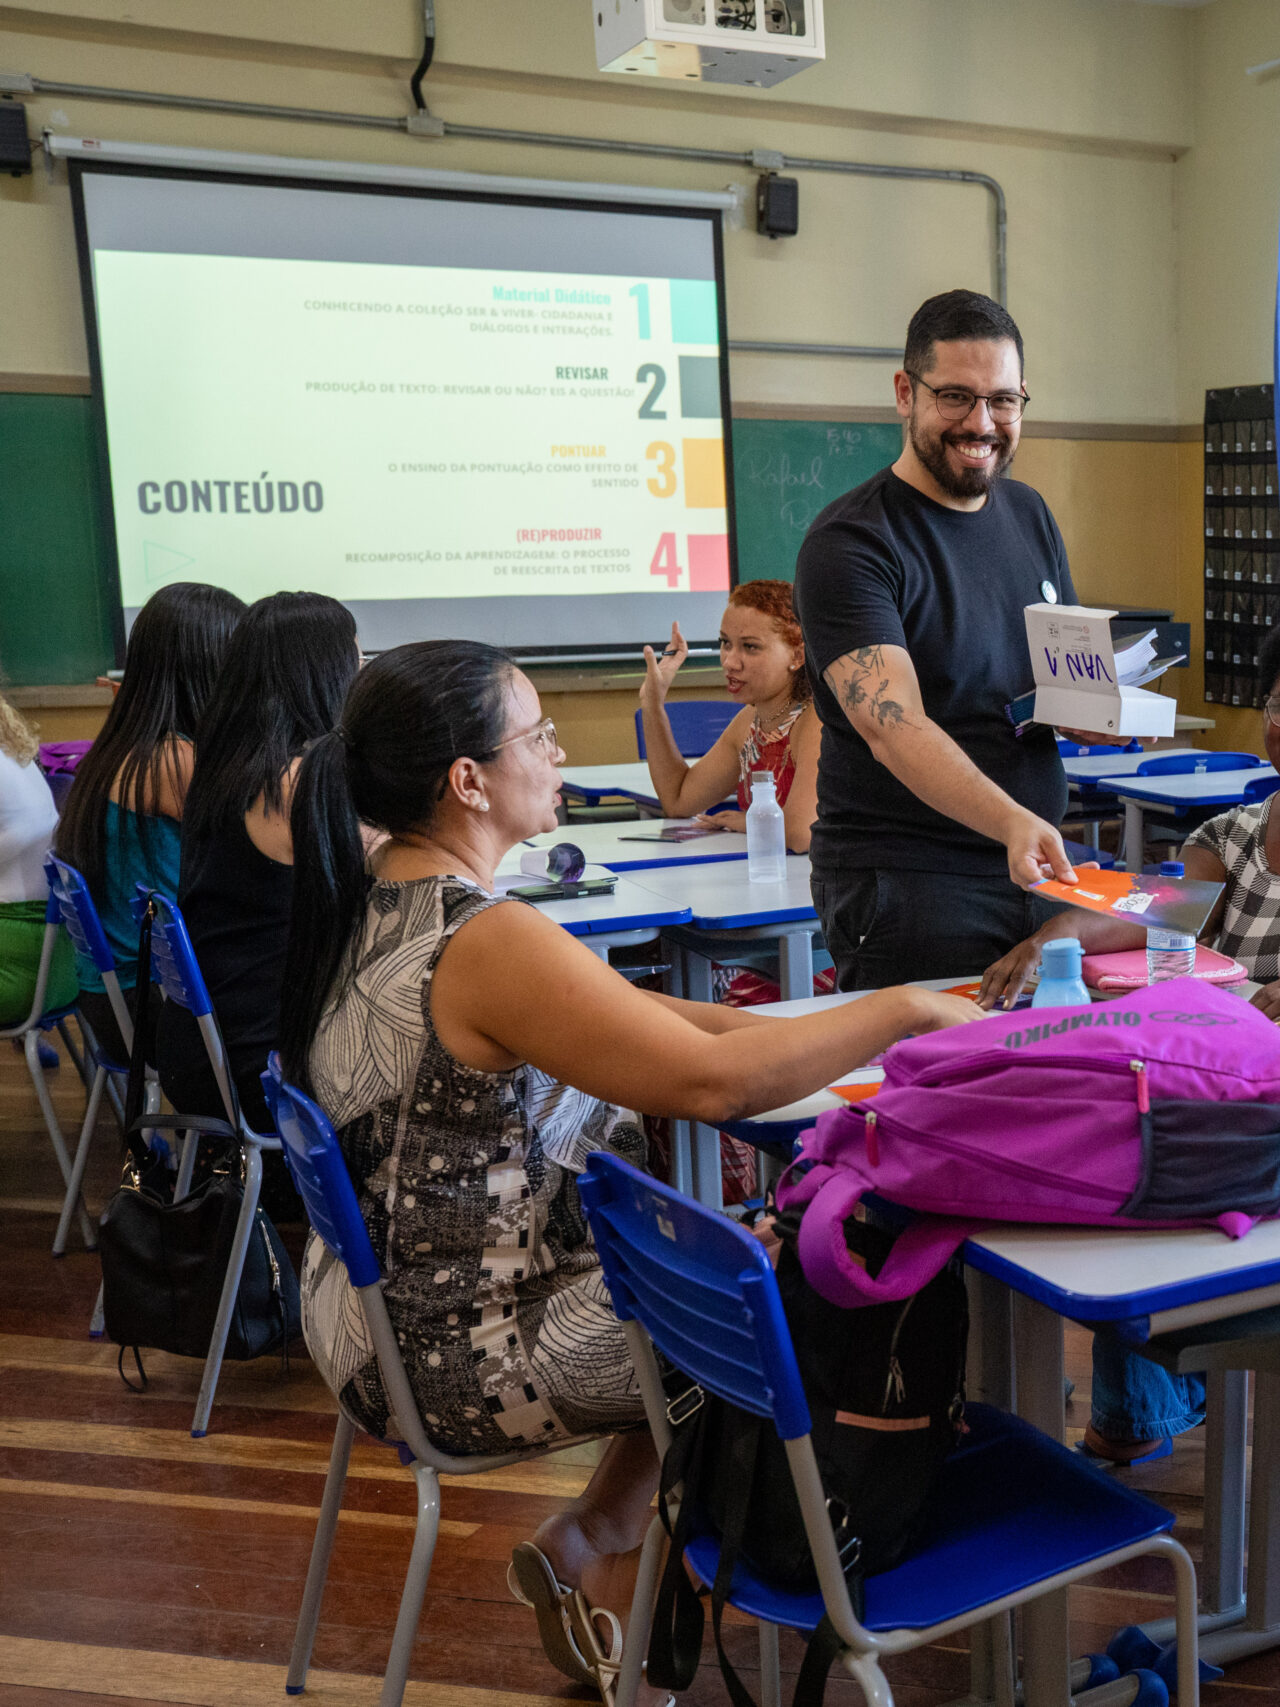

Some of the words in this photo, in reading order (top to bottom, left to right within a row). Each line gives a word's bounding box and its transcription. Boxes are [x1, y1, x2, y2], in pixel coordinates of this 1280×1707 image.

[492, 286, 550, 303] Material
[554, 289, 611, 305] Didático
[304, 300, 392, 313] CONHECENDO
[395, 304, 404, 314] A
[407, 303, 463, 317] COLEÇÃO
[466, 307, 486, 316] SER
[490, 308, 499, 317] &
[541, 310, 604, 321] CIDADANIA
[607, 312, 613, 321] E
[629, 283, 651, 340] 1
[470, 321, 530, 334] DIÁLOGOS
[533, 325, 539, 334] E
[555, 366, 608, 380] REVISAR
[305, 380, 377, 395] PRODUÇÃO
[380, 383, 395, 394] DE
[400, 383, 441, 395] TEXTO:
[443, 384, 491, 396] REVISAR
[494, 385, 512, 395] OU
[515, 382, 547, 396] NÃO?
[550, 386, 567, 397] EIS
[569, 387, 578, 397] A
[580, 386, 635, 400] QUESTÃO!
[636, 363, 667, 420] 2
[551, 445, 606, 458] PONTUAR
[388, 463, 398, 473] O
[401, 463, 447, 473] ENSINO
[450, 463, 468, 473] DA
[470, 462, 543, 476] PONTUAÇÃO
[546, 463, 581, 473] COMO
[584, 463, 621, 473] EFEITO
[624, 463, 639, 473] DE
[645, 440, 677, 498] 3
[591, 478, 639, 488] SENTIDO
[137, 471, 324, 515] CONTEÚDO
[516, 528, 602, 543] (RE)PRODUZIR
[345, 549, 442, 564] RECOMPOSIÇÃO
[445, 551, 462, 562] DA
[465, 549, 558, 561] APRENDIZAGEM:
[561, 549, 570, 560] O
[573, 548, 631, 559] PROCESSO
[649, 532, 683, 588] 4
[494, 566, 508, 576] DE
[511, 564, 570, 576] REESCRITA
[573, 564, 587, 575] DE
[590, 562, 631, 574] TEXTOS
[1066, 652, 1113, 683] VAN
[1001, 1011, 1141, 1050] OLYMPIKU
